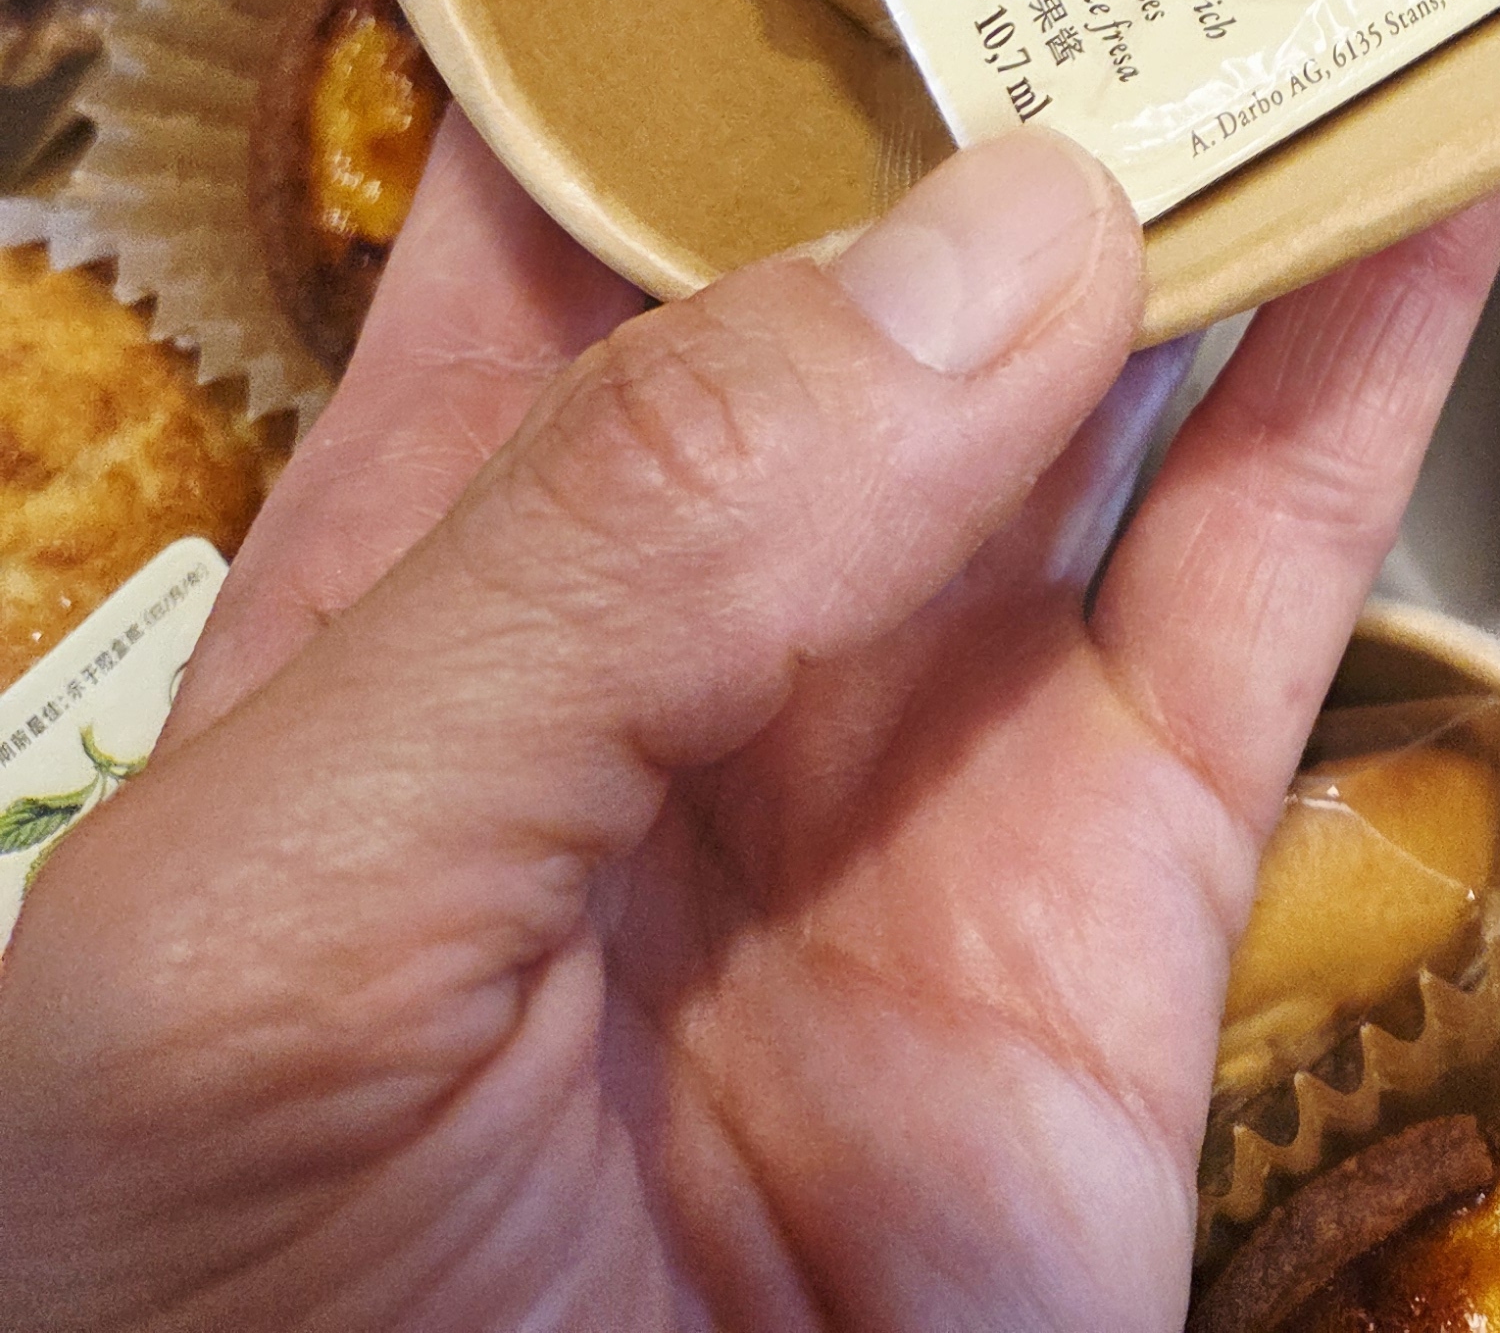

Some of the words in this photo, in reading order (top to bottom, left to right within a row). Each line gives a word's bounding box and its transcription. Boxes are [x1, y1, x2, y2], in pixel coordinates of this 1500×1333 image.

[974, 5, 1032, 73] 10,7
[1006, 76, 1054, 124] ml
[1084, 20, 1140, 83] fresa
[1190, 129, 1216, 158] A.
[1214, 88, 1284, 139] Darbo
[1289, 57, 1332, 97] AG,
[1332, 21, 1383, 68] 6135
